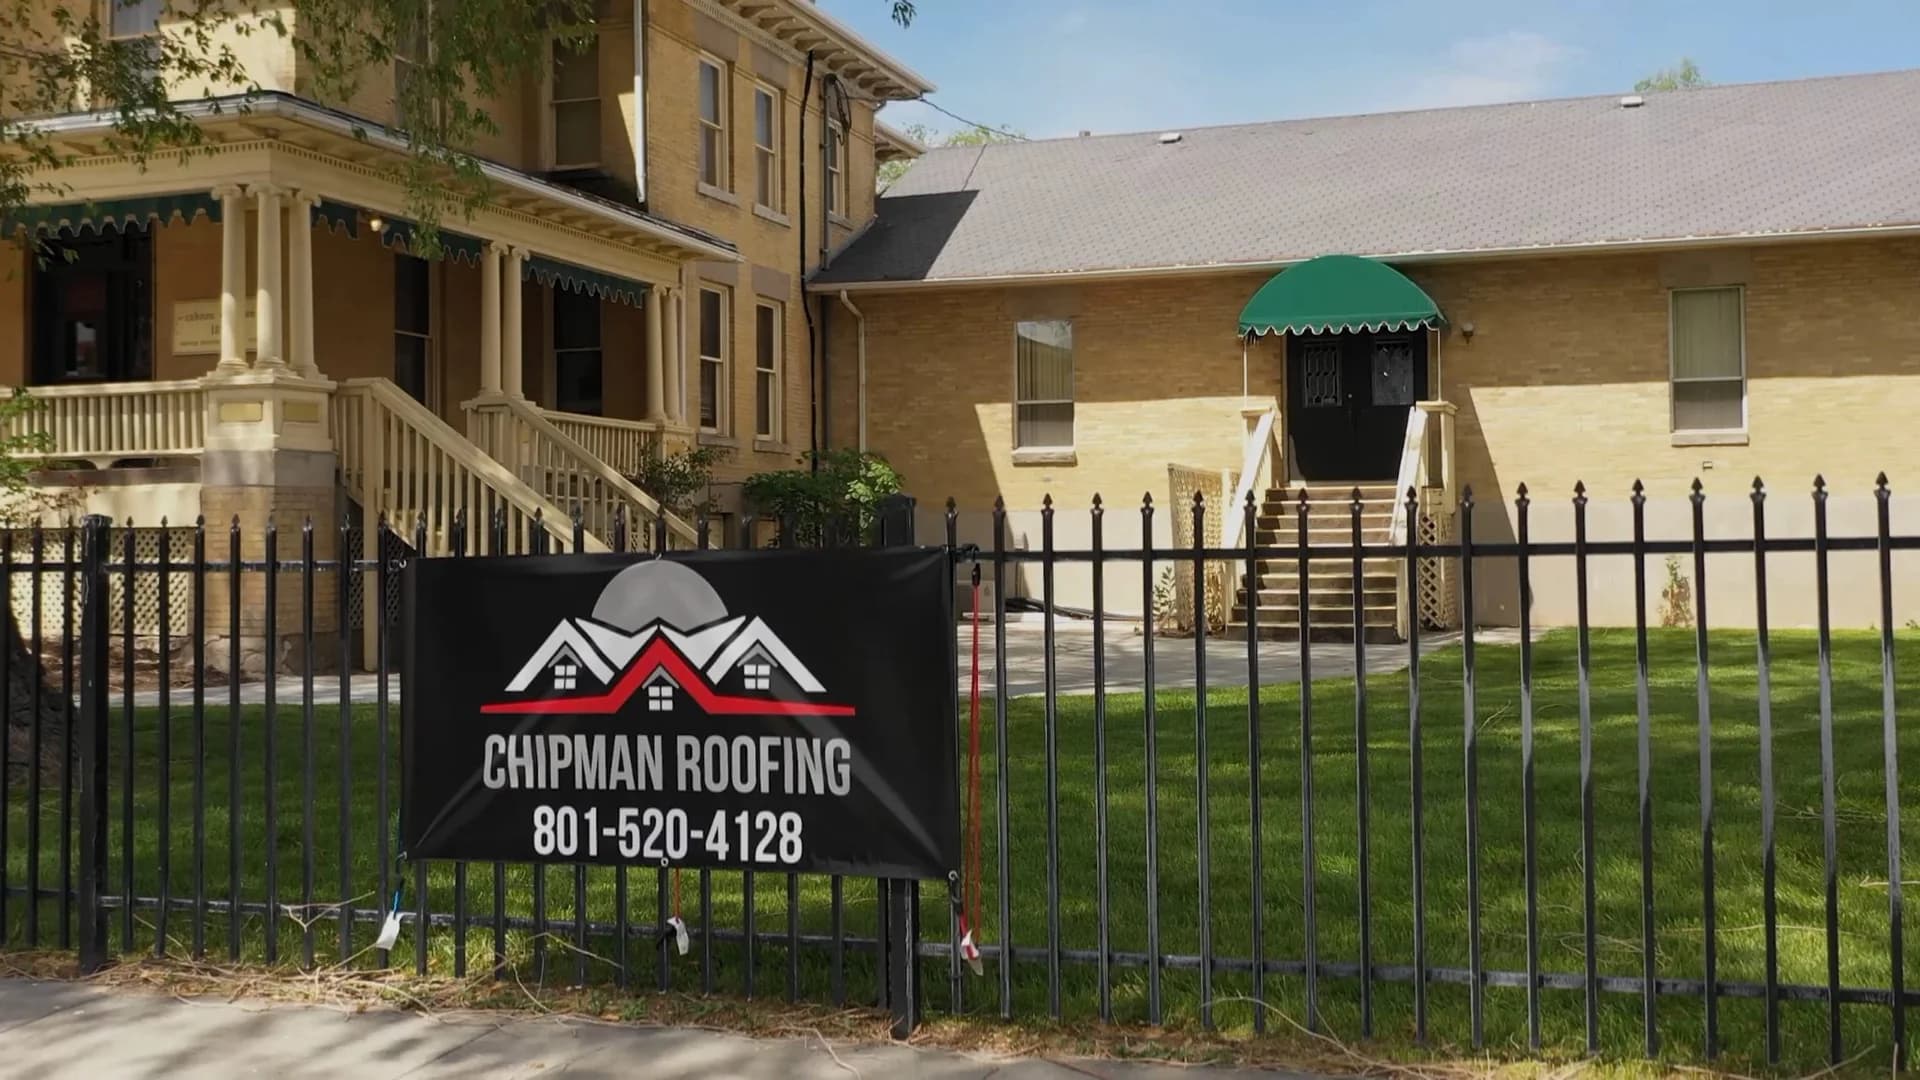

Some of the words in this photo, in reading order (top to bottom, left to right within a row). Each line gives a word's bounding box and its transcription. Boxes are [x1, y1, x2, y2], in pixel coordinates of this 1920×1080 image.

[483, 734, 664, 791] CHIPMAN
[677, 736, 851, 796] ROOFING
[533, 805, 803, 865] 801-520-4128
